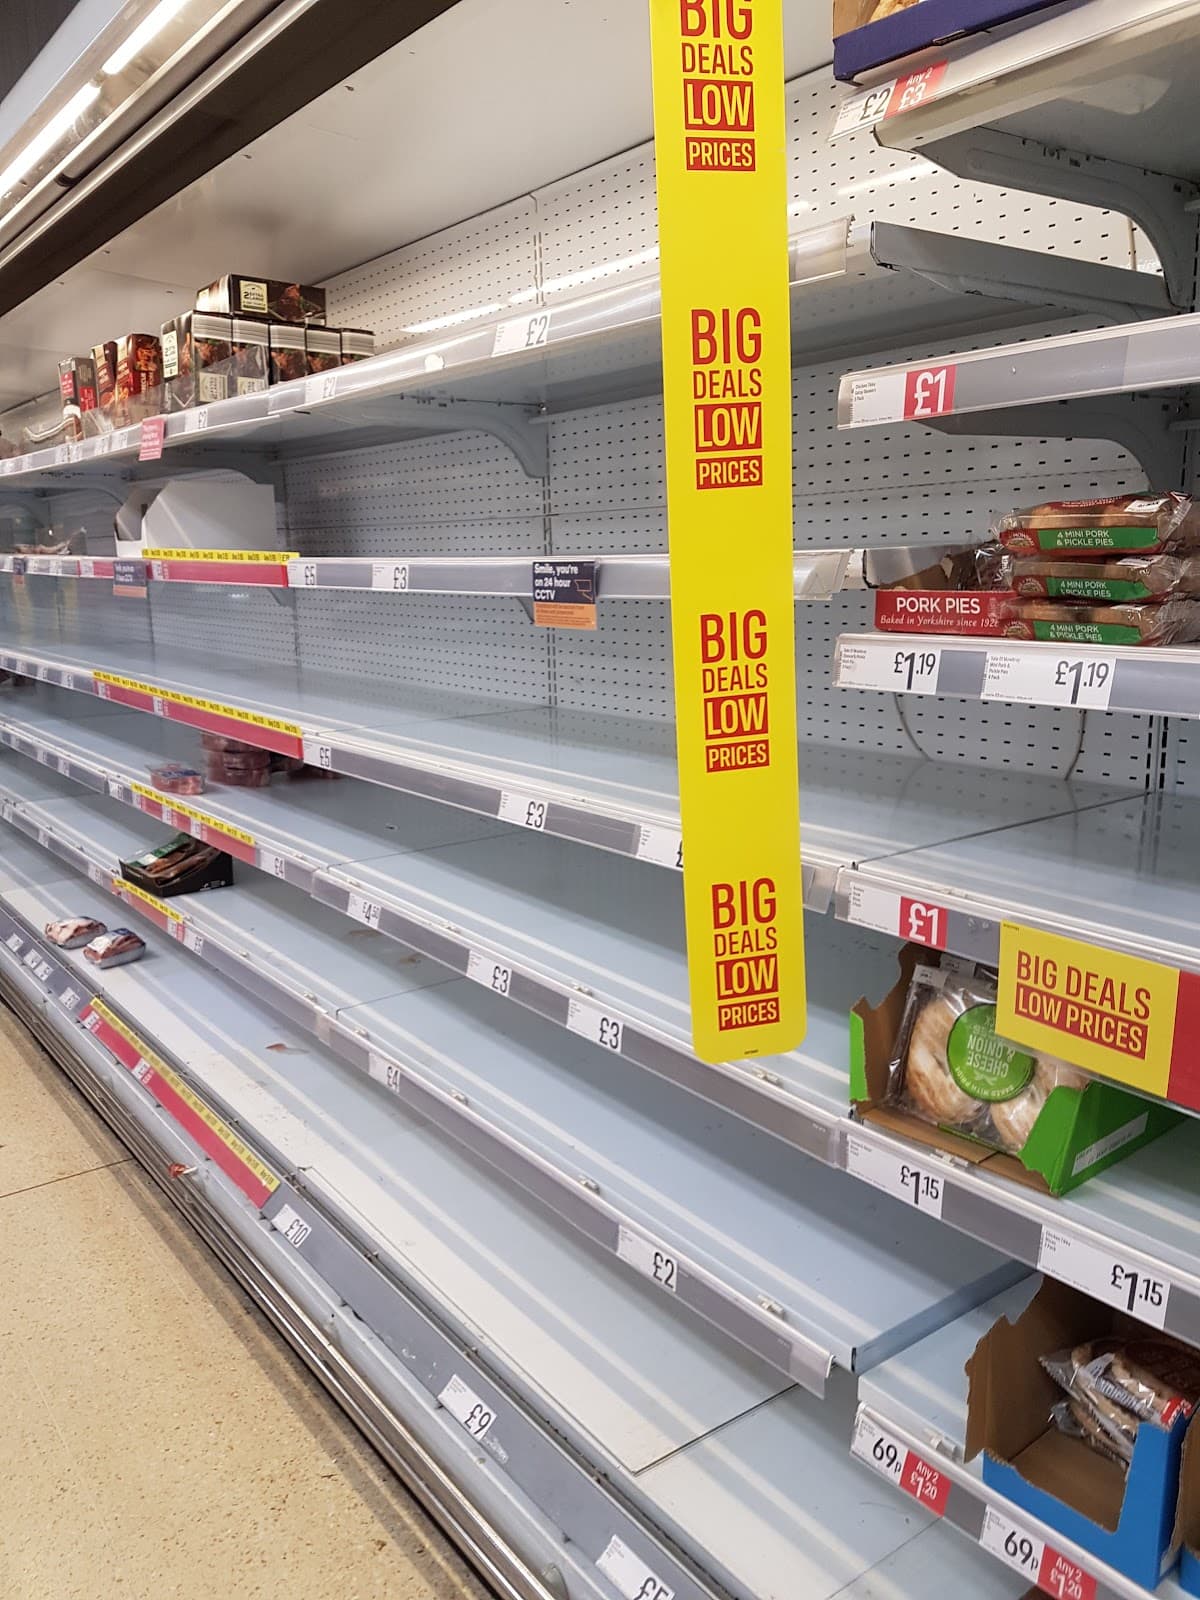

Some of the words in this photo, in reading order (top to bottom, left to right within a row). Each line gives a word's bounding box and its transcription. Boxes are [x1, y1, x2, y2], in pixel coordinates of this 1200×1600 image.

[680, 0, 753, 40] BIG
[681, 42, 753, 75] DEALS
[906, 74, 923, 86] Any
[925, 67, 932, 79] 2
[687, 83, 751, 126] LOW
[859, 88, 890, 120] £2
[898, 82, 926, 110] £3
[688, 141, 753, 167] PRICES
[525, 315, 547, 347] £2
[691, 307, 762, 365] BIG
[693, 368, 762, 399] DEALS
[914, 368, 947, 417] £1
[698, 406, 760, 448] LOW
[699, 459, 760, 486] PRICES
[1064, 538, 1094, 546] PICKLE
[1095, 538, 1114, 547] PIES
[1065, 531, 1084, 539] MINI
[1085, 530, 1110, 538] PORK
[305, 566, 315, 586] £5
[394, 566, 407, 589] £3
[534, 563, 555, 575] Smile,
[556, 564, 578, 576] you're
[535, 579, 543, 587] on
[544, 577, 553, 587] 24
[554, 576, 571, 588] hour
[535, 589, 556, 600] CCTV
[1065, 589, 1093, 597] PICKLE
[1094, 590, 1111, 598] PIES
[1066, 581, 1083, 589] MINI
[1084, 581, 1107, 589] PORK
[896, 597, 941, 613] PORK
[945, 597, 981, 614] PIES
[880, 615, 905, 624] Baked
[907, 616, 914, 624] in
[917, 615, 954, 626] Yorkshire
[957, 617, 977, 627] since
[1056, 624, 1073, 632] MINI
[1075, 625, 1099, 633] PORK
[700, 609, 767, 664] BIG
[1056, 632, 1083, 640] PICKLE
[702, 663, 767, 693] DEALS
[894, 652, 936, 690] £1.19
[1055, 660, 1109, 704] £1.19
[706, 696, 766, 736] LOW
[320, 747, 330, 767] £5
[708, 743, 767, 768] PRICES
[525, 801, 544, 828] £3
[274, 857, 284, 877] £4
[712, 877, 776, 929] BIG
[908, 903, 939, 945] £1
[714, 927, 777, 957] DEALS
[492, 966, 509, 993] £3
[719, 957, 776, 996] LOW
[1017, 950, 1057, 990] BIG
[1066, 965, 1151, 1021] DEALS
[721, 1001, 777, 1027] PRICES
[1018, 987, 1062, 1025] LOW
[1065, 1004, 1143, 1053] PRICES
[599, 1017, 619, 1050] £3
[967, 1034, 1003, 1057] ONION
[966, 1051, 1009, 1078] CHEESE
[1006, 1049, 1016, 1062] &
[387, 1066, 398, 1089] £4
[900, 1165, 939, 1205] £1.15
[284, 1218, 309, 1246] £10
[653, 1251, 674, 1288] £2
[1111, 1264, 1163, 1312] £1.15
[464, 1403, 491, 1435] £9
[873, 1437, 902, 1473] 69p
[910, 1471, 937, 1500] £1.20
[916, 1461, 931, 1478] Any
[931, 1472, 939, 1484] 2
[1004, 1531, 1039, 1572] 69p
[1056, 1556, 1077, 1577] Any
[1076, 1570, 1083, 1582] 2
[1050, 1567, 1083, 1600] £1.20
